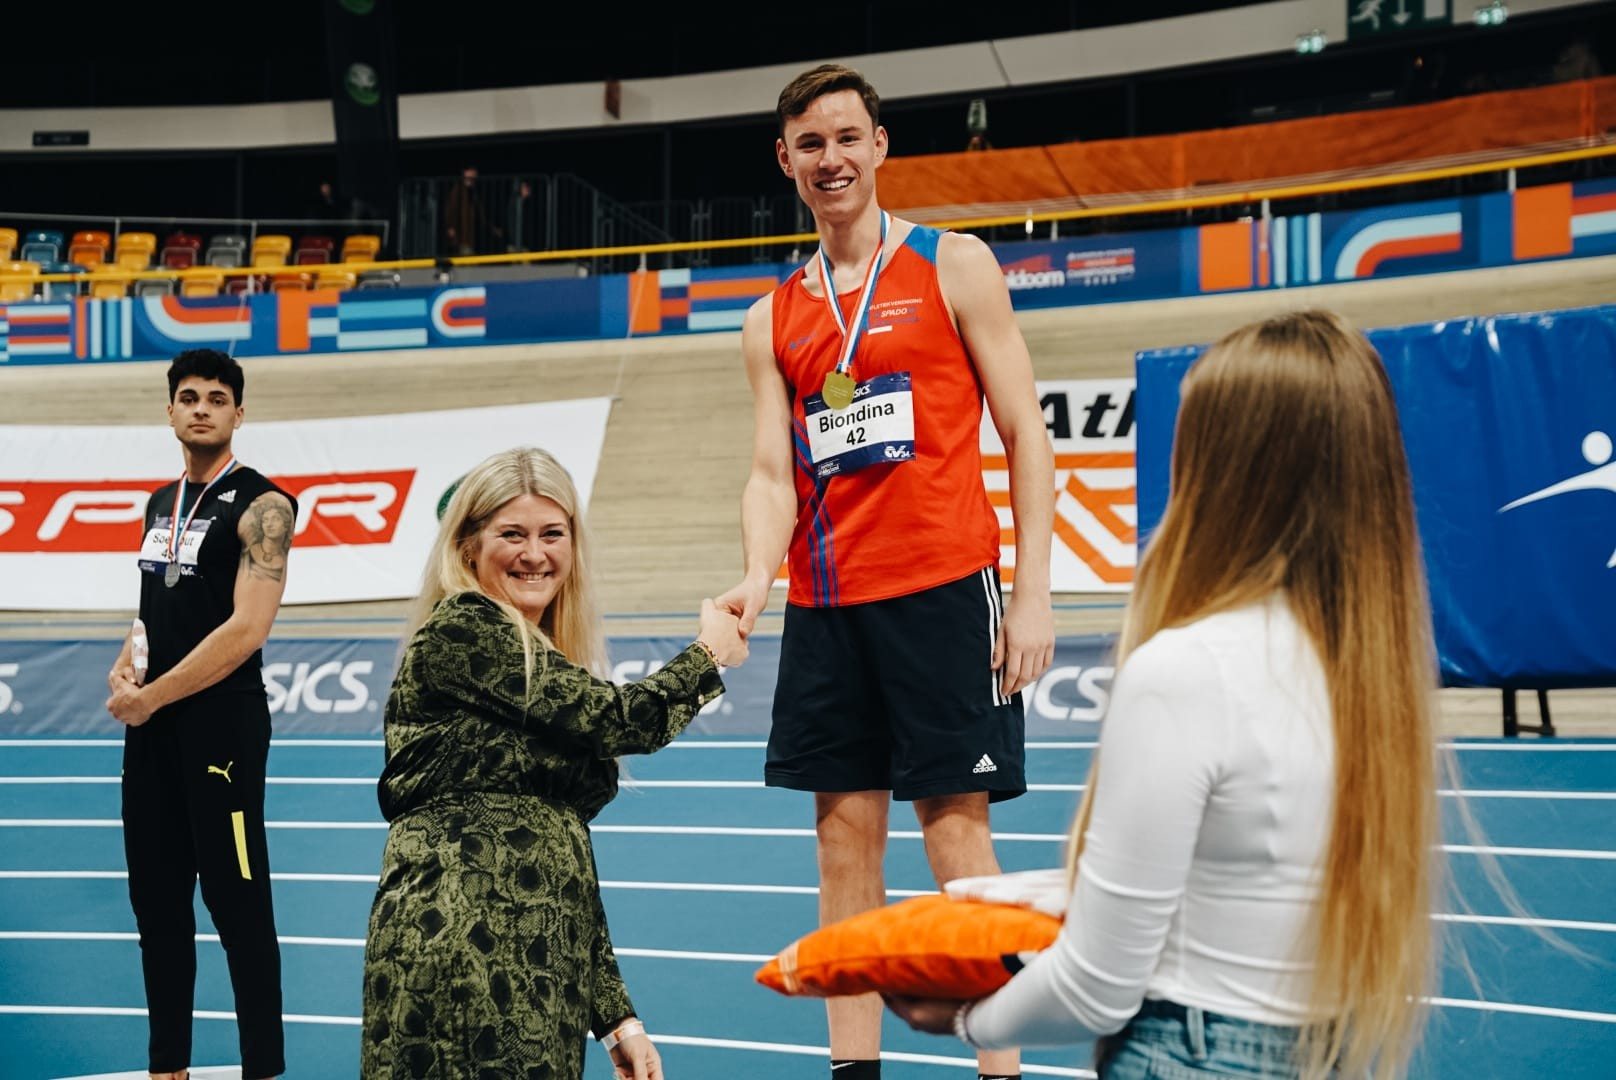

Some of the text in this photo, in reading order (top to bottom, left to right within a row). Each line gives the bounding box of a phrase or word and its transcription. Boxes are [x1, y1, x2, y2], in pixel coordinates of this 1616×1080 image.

[881, 307, 908, 318] SPADO
[854, 384, 871, 399] SICS
[819, 402, 895, 433] Biondina
[846, 426, 867, 446] 42
[261, 660, 374, 714] SICS
[972, 764, 998, 774] adidas
